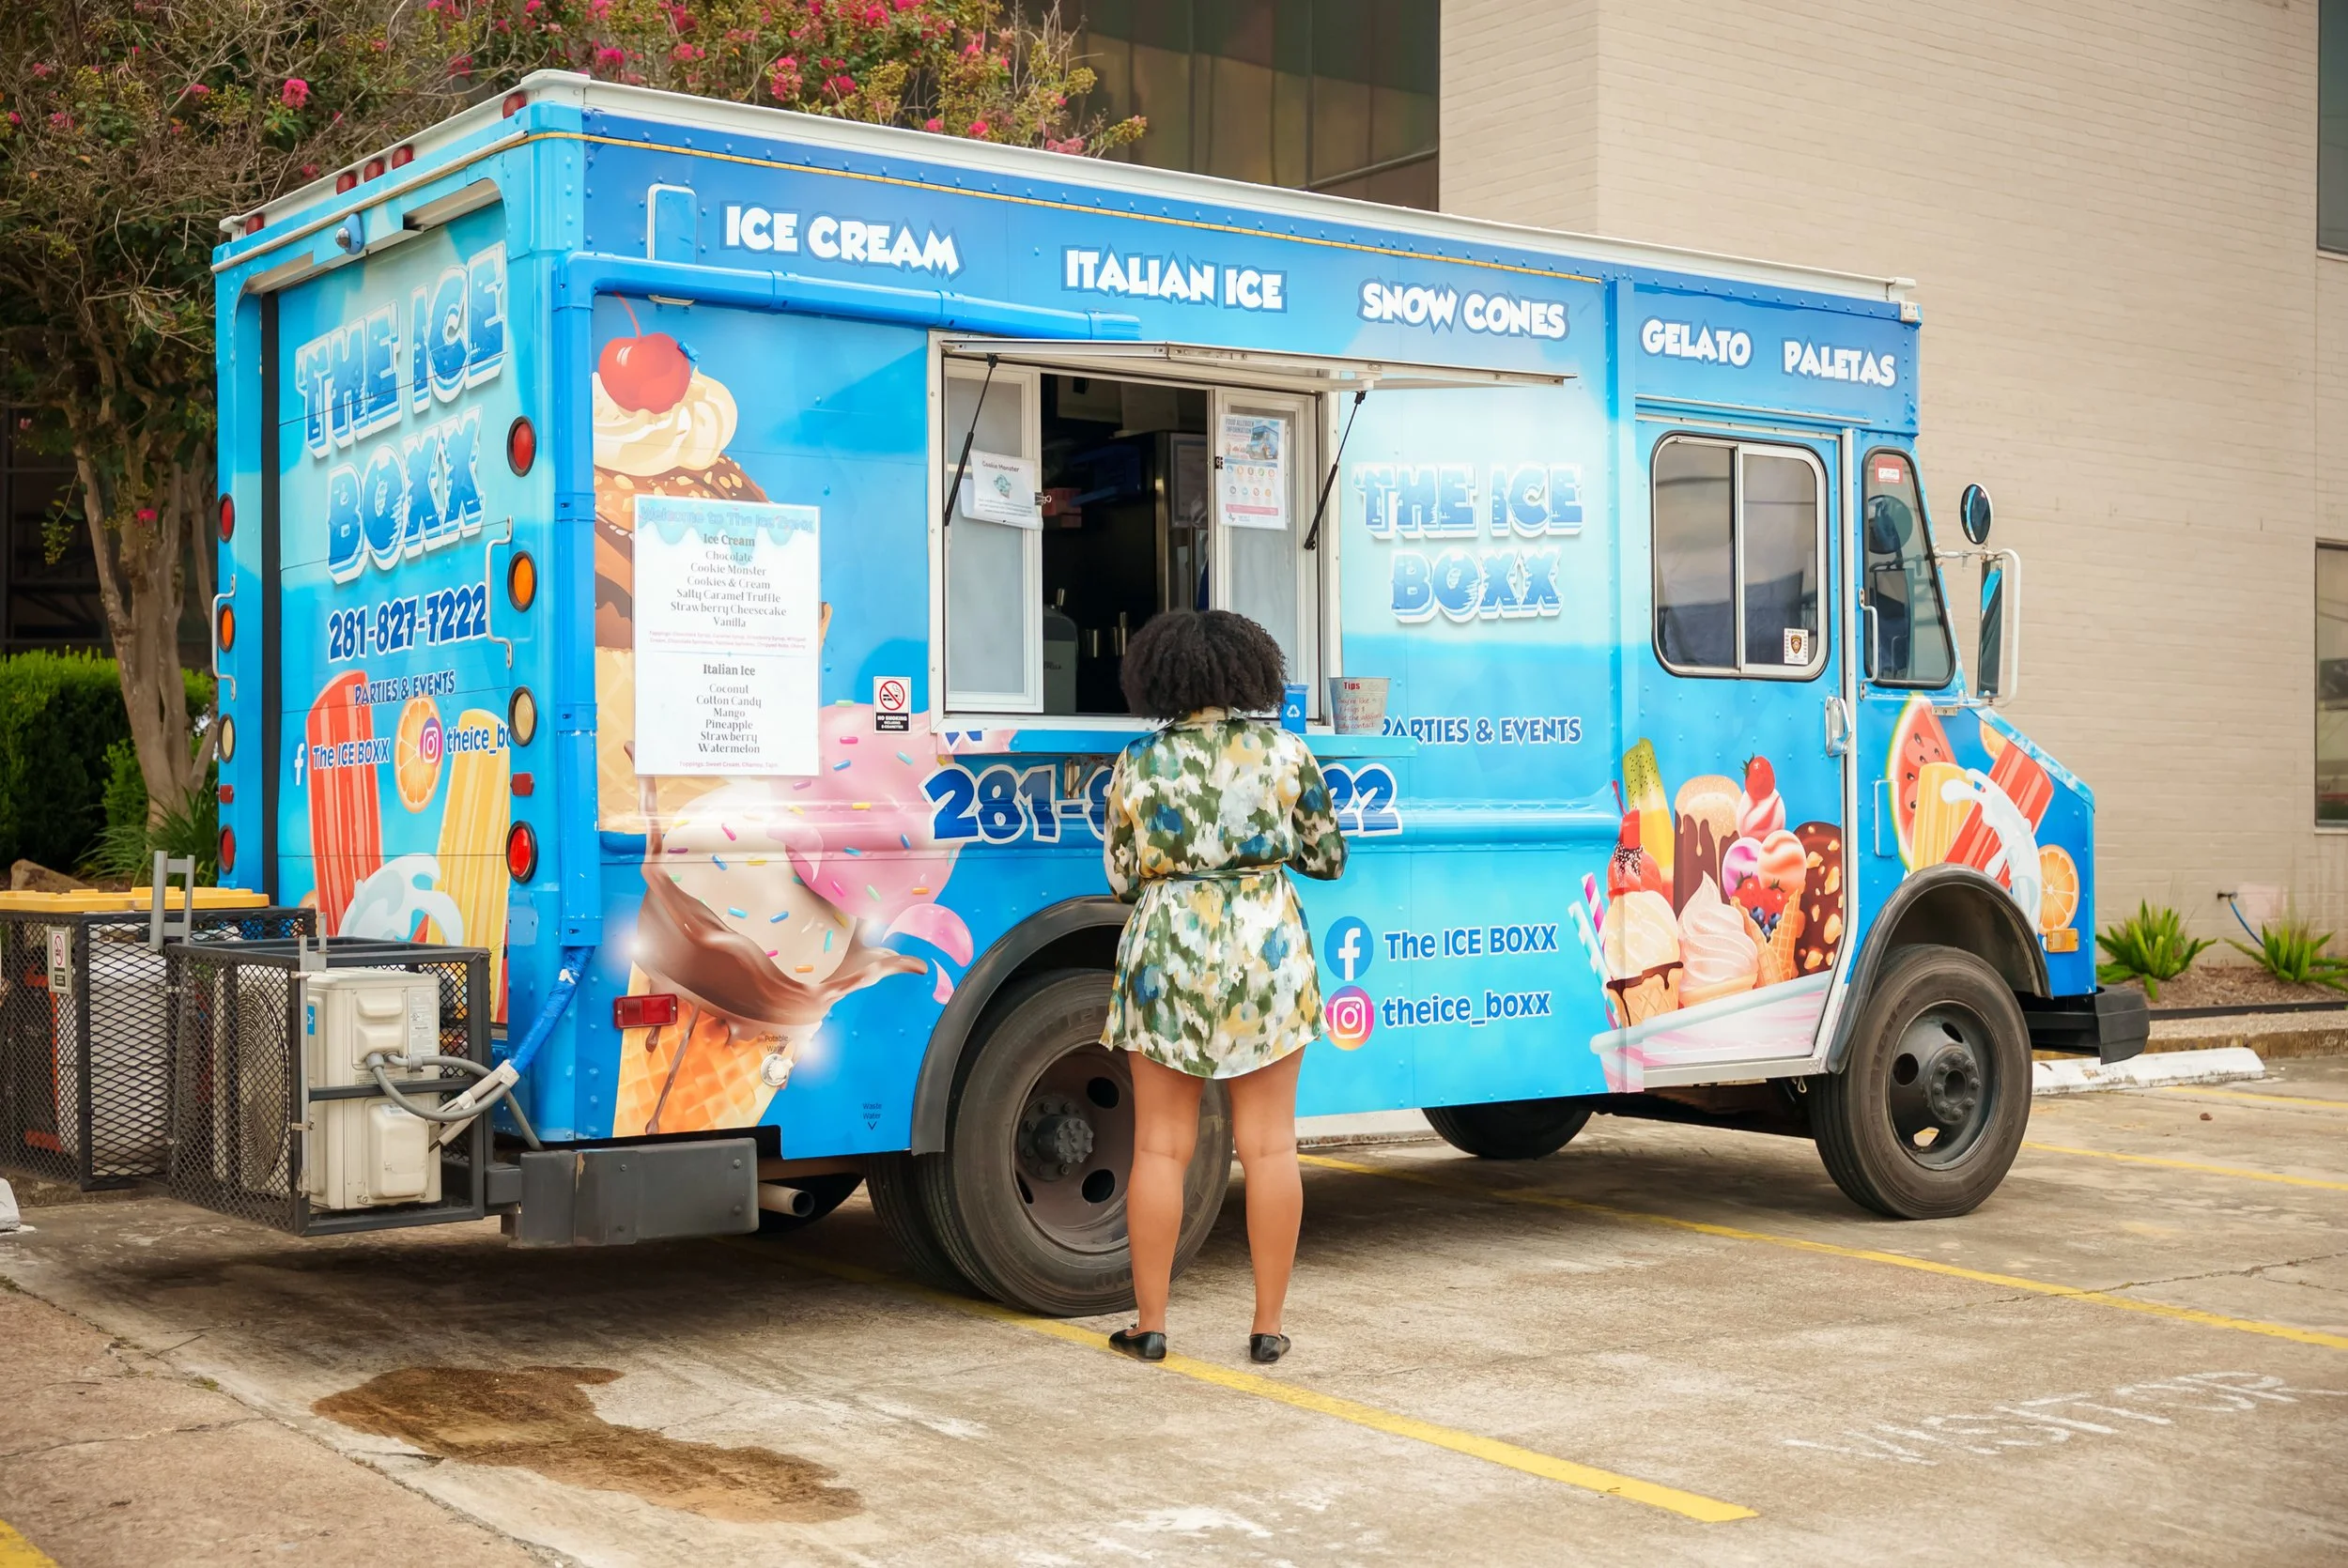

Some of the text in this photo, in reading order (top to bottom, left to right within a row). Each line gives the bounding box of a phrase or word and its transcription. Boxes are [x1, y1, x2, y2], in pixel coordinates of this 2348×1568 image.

[725, 206, 962, 275] ICE CREAM
[1065, 249, 1284, 310] ITALIAN ICE
[1362, 284, 1567, 339] SNOW CONES
[295, 240, 507, 459] THE ICE
[1642, 323, 1752, 366] GELATO
[1784, 342, 1896, 387] PALETAS
[327, 404, 486, 585] BOXX
[1352, 463, 1584, 540] THE ICE
[703, 533, 755, 547] Ice Cream
[705, 550, 753, 562] Chocolate
[690, 562, 767, 576] Cookie Monster
[687, 576, 770, 590] Cookies & Cream
[1390, 546, 1564, 623] BOXX
[676, 589, 781, 603] Salty Caramel Truffle
[671, 601, 787, 616] Strawberry Cheesecake
[328, 581, 487, 663] 281-827-7222
[713, 617, 747, 628] Vanilla
[703, 663, 756, 676] Italian Ice
[354, 670, 456, 706] PARTIES & EVENTS
[709, 683, 749, 694] Coconut
[1343, 682, 1361, 690] Tips
[696, 695, 762, 709] Cotton Candy
[713, 708, 746, 720] Mango
[705, 718, 753, 732] Pineapple
[1475, 717, 1495, 745] &
[1500, 716, 1582, 746] EVENTS
[700, 730, 758, 745] Strawberry
[313, 746, 334, 770] The
[337, 740, 355, 767] ICE
[357, 737, 391, 766] BOXX
[698, 743, 760, 754] Watermelon
[1383, 930, 1436, 961] The
[1443, 928, 1483, 958] ICE
[1489, 923, 1559, 954] BOXX
[1382, 990, 1551, 1028] theice_boxx
[765, 1034, 789, 1042] Potable
